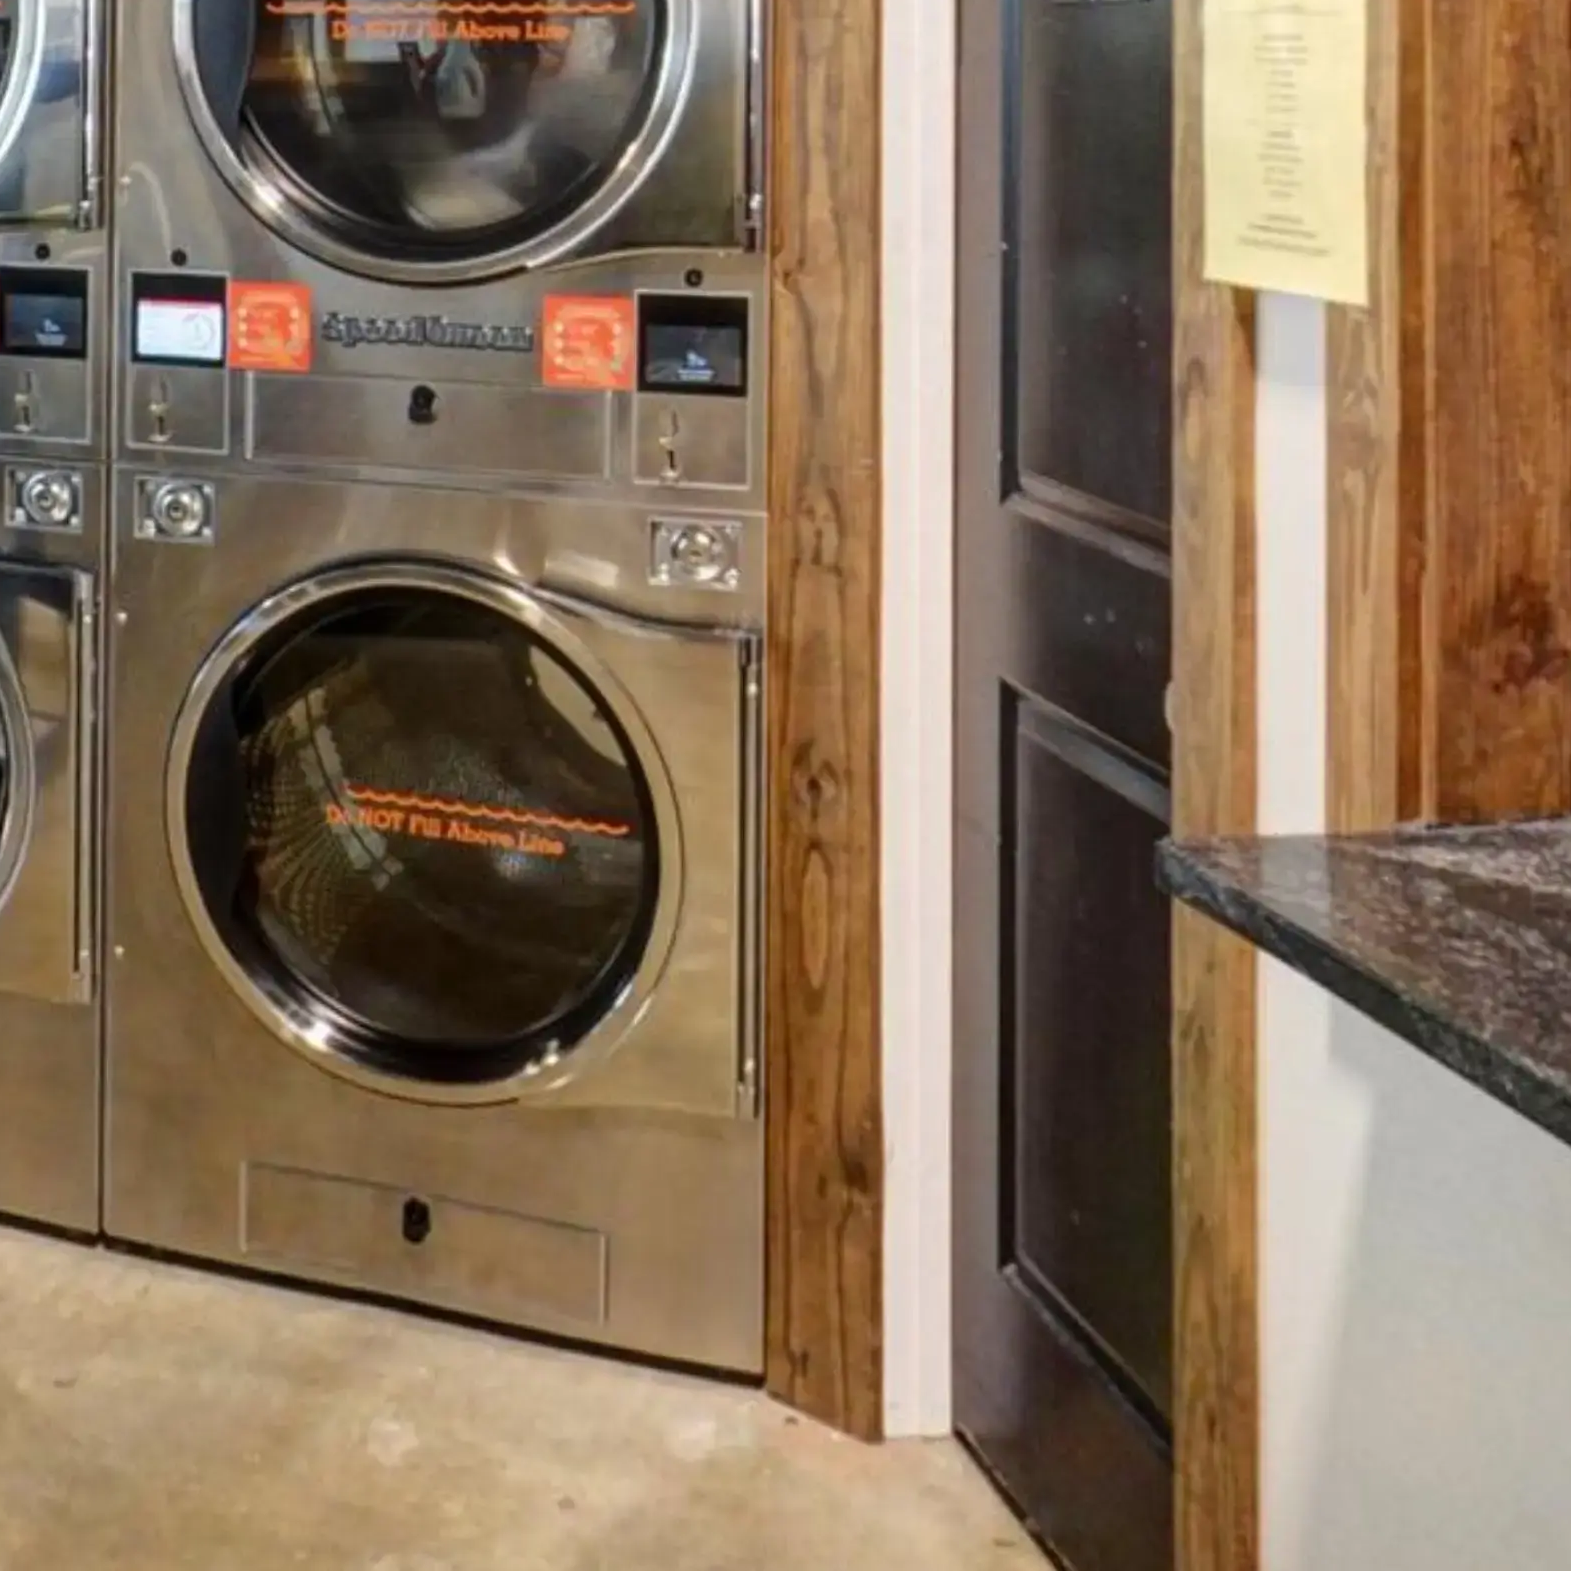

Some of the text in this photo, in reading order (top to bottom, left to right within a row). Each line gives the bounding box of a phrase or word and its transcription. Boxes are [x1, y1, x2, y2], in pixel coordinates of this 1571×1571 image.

[457, 19, 521, 41] Above
[359, 807, 406, 829] NOT
[409, 815, 442, 838] Fill
[448, 820, 516, 847] Above
